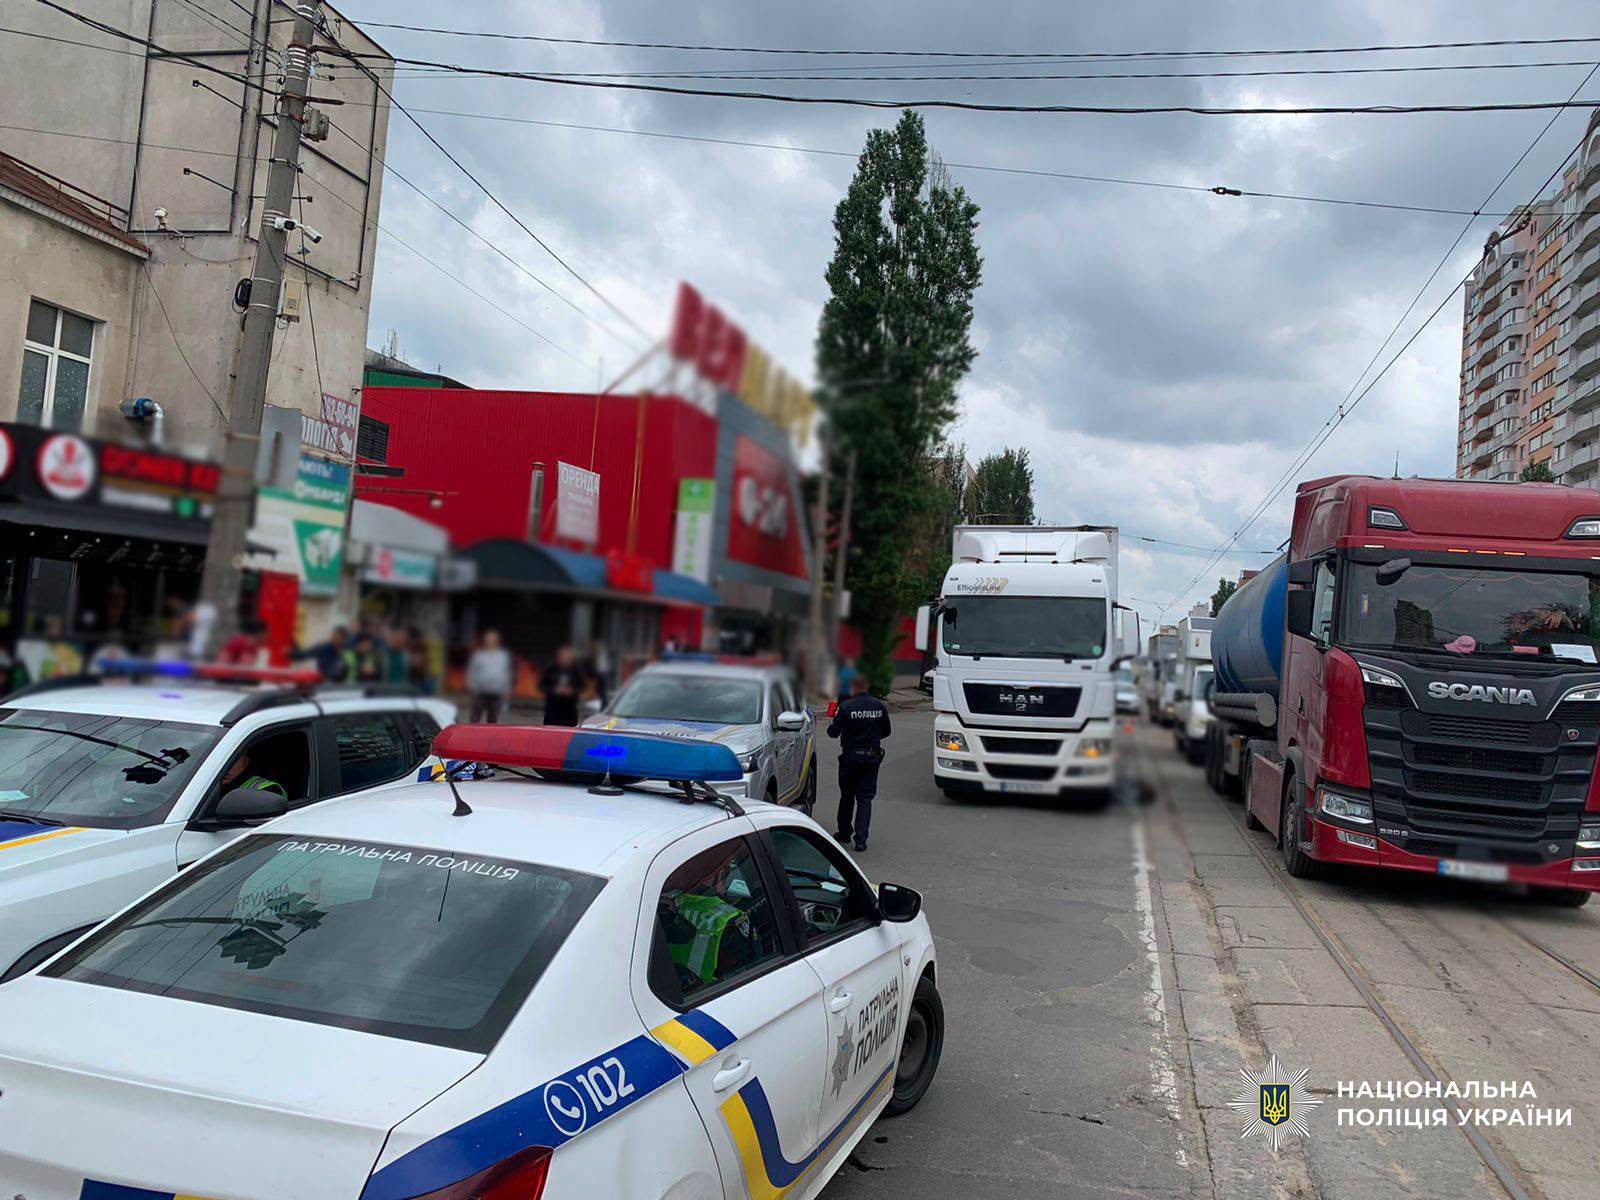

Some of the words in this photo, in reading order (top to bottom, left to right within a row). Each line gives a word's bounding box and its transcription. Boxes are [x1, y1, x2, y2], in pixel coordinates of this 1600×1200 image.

[560, 466, 600, 497] ОРЕНДА
[999, 693, 1044, 704] MAN
[1427, 681, 1538, 707] SCANIA
[850, 710, 883, 720] ПОЛІЦІЯ
[277, 840, 413, 864] ПАТРУЛЬНА
[416, 853, 521, 882] ПОЛІЦІЯ
[858, 976, 899, 1034] ПАТРУЛЬНА
[853, 1003, 898, 1076] ПОЛІЦІЯ
[575, 1056, 636, 1113] 102
